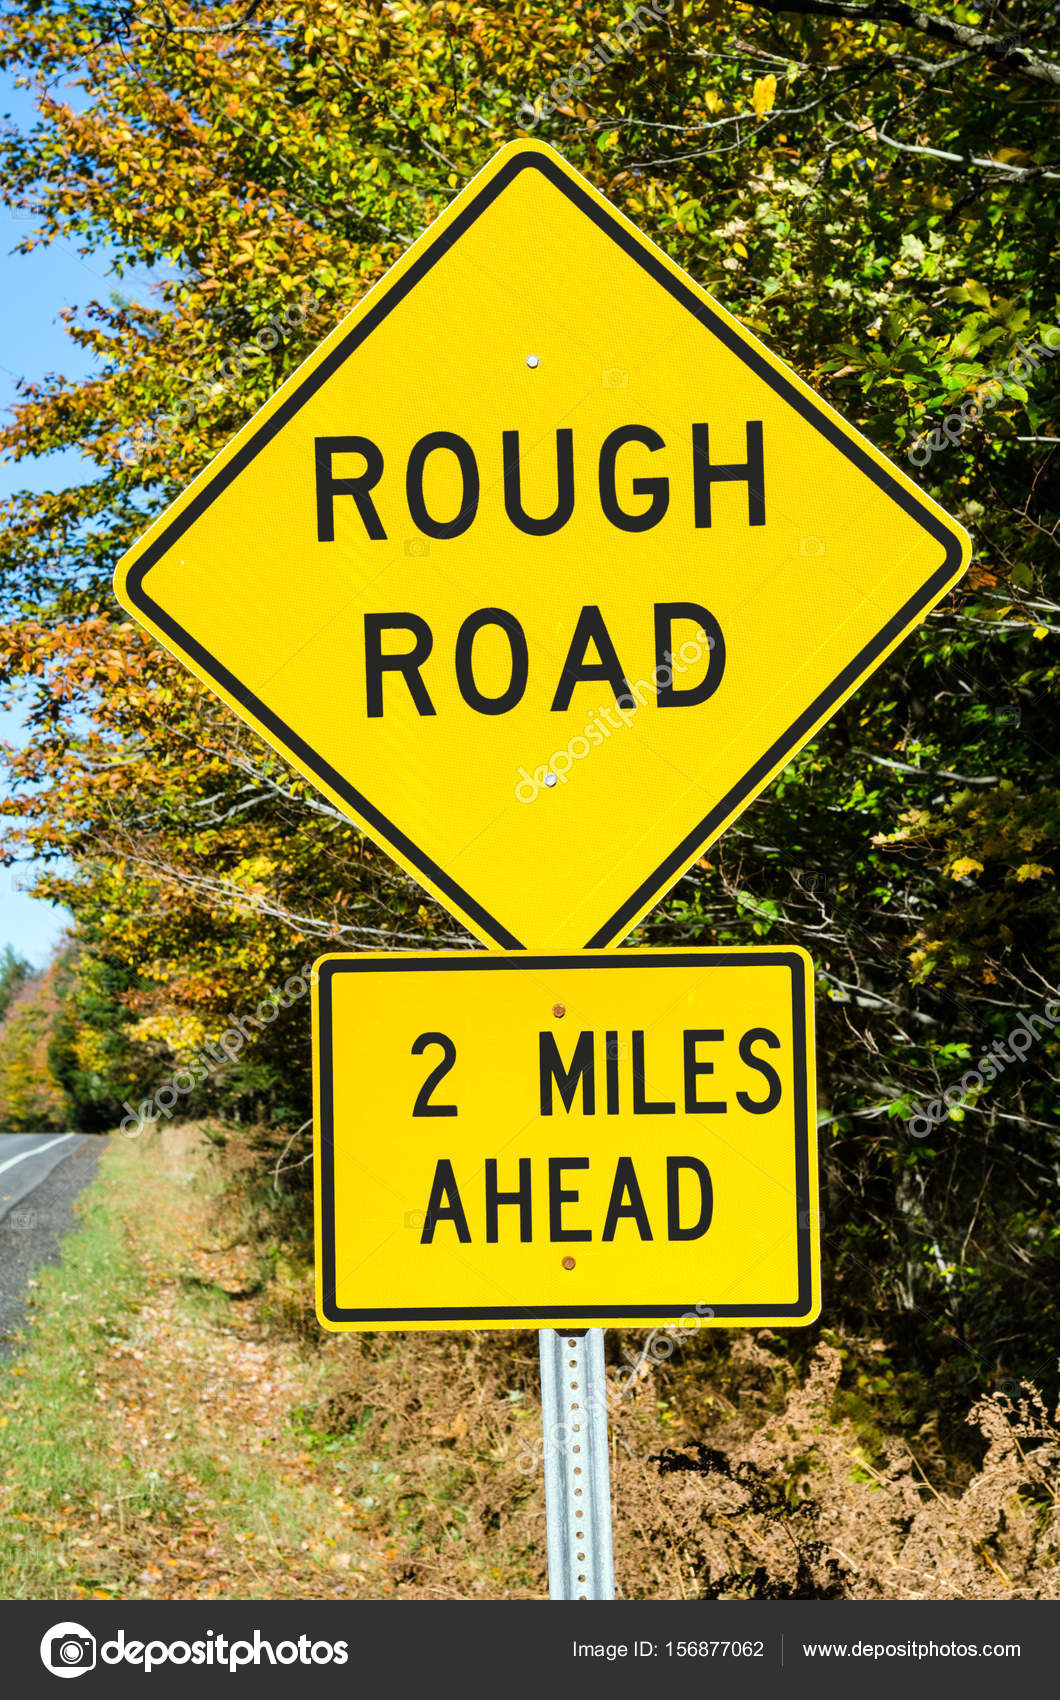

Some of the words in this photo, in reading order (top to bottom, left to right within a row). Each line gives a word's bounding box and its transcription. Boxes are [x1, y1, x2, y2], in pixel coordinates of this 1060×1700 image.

[315, 421, 765, 541] ROUGH
[364, 603, 726, 717] ROAD
[412, 1032, 458, 1117] 2
[539, 1028, 782, 1115] MILES
[421, 1156, 714, 1244] AHEAD
